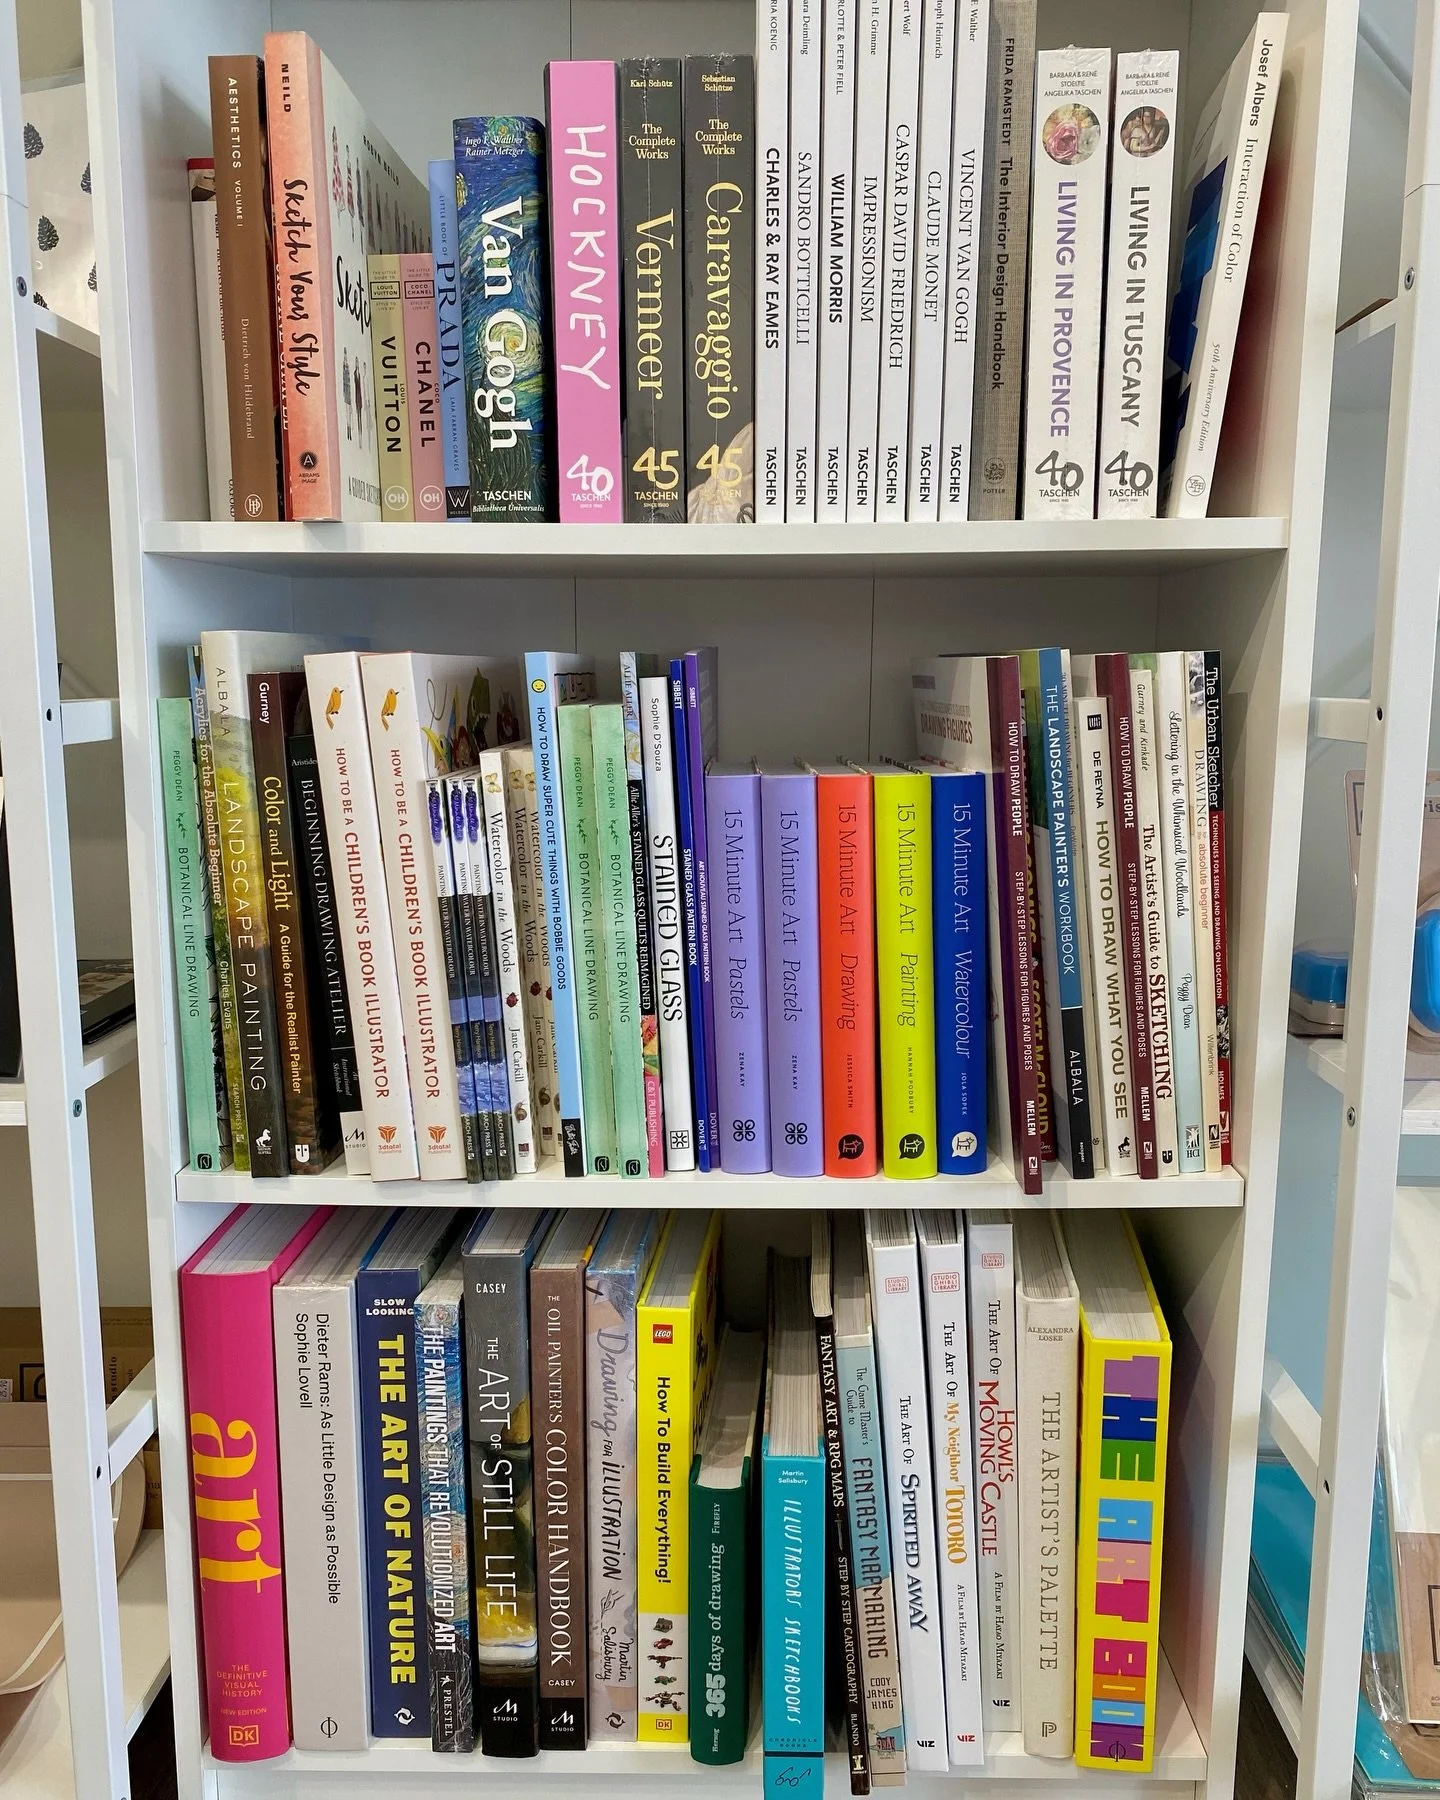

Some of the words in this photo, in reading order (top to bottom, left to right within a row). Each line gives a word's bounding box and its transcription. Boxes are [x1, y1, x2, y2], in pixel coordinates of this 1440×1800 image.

[701, 75, 736, 83] Sebastian
[836, 43, 844, 71] PETER
[1005, 38, 1015, 76] FRIDA
[1259, 39, 1273, 78] Josef
[281, 64, 291, 113] NEILD
[630, 79, 647, 88] Karl
[648, 79, 673, 88] Schütz
[836, 73, 844, 95] FIELL
[1075, 88, 1101, 96] TASCHEN
[1249, 81, 1269, 127] Albers
[642, 123, 662, 135] The
[1002, 79, 1014, 146] RAMSTEDT
[228, 77, 242, 169] AESTHETICS
[235, 180, 243, 220] VOLUME
[465, 147, 491, 156] Rainer
[493, 147, 525, 157] Metzger
[628, 136, 676, 147] Complete
[635, 149, 669, 160] Works
[894, 123, 910, 197] CASPAR
[766, 147, 780, 228] CHARLES
[797, 152, 812, 231] SANDRO
[959, 148, 975, 237] VINCENT
[1000, 157, 1013, 186] The
[1233, 138, 1258, 220] Interaction
[282, 178, 312, 263] Sketch
[830, 173, 845, 248] WILLIAM
[892, 202, 908, 263] DAVID
[926, 171, 942, 248] CLAUDE
[997, 188, 1011, 253] Interior
[1055, 181, 1078, 266] LIVING
[1127, 186, 1150, 271] LIVING
[1231, 222, 1243, 241] of
[481, 196, 524, 299] Van
[561, 124, 611, 390] HOCKNEY
[766, 232, 780, 247] &
[861, 176, 878, 323] IMPRESSIONISM
[957, 244, 972, 282] VAN
[1224, 243, 1242, 283] Color
[286, 271, 313, 319] Your
[766, 254, 779, 285] RAY
[796, 236, 811, 345] BOTTICELLI
[829, 255, 844, 324] MORRIS
[924, 254, 940, 322] MONET
[993, 254, 1009, 310] Design
[1054, 274, 1074, 299] IN
[1126, 278, 1146, 304] IN
[436, 262, 461, 391] PRADA
[635, 208, 675, 400] Vermeer
[695, 182, 744, 420] Caravaggio
[765, 291, 779, 349] EAMES
[889, 268, 907, 369] FRIEDRICH
[954, 287, 970, 344] GOGH
[241, 318, 251, 359] Dietrich
[287, 332, 320, 396] Style
[991, 311, 1007, 390] Handbook
[381, 335, 402, 453] VUITTON
[415, 341, 435, 448] CHANEL
[474, 308, 534, 452] Gogh
[1050, 307, 1074, 437] PROVENCE
[1120, 311, 1145, 428] TUSCANY
[244, 378, 255, 440] Hildebrand
[483, 490, 531, 500] TASCHEN
[766, 447, 776, 505] TASCHEN
[215, 667, 231, 736] ALBALA
[259, 682, 270, 725] Gurney
[1046, 685, 1058, 714] THE
[1206, 667, 1218, 695] The
[651, 697, 660, 731] Sophie
[1207, 700, 1219, 743] Urban
[653, 734, 662, 772] D'Souza
[1047, 716, 1064, 809] LANDSCAPE
[1092, 751, 1102, 768] DE
[1207, 747, 1219, 808] Sketcher
[263, 776, 282, 826] Color
[543, 785, 553, 818] SUPER
[838, 804, 857, 822] 15
[1093, 770, 1104, 809] REYNA
[269, 828, 283, 856] and
[490, 811, 507, 886] Watercolor
[546, 820, 556, 846] CUTE
[1053, 811, 1069, 888] PAINTER'S
[178, 847, 193, 920] BOTANICAL
[269, 860, 290, 911] Light
[548, 848, 558, 885] THINGS
[839, 829, 857, 898] Minute
[1144, 854, 1157, 908] Artist's
[183, 924, 195, 951] LINE
[224, 782, 254, 949] LANDSCAPE
[240, 963, 267, 1091] PAINTING
[840, 903, 858, 936] Art
[1059, 891, 1075, 975] WORKBOOK
[1147, 910, 1160, 953] Guide
[186, 956, 199, 1017] DRAWING
[410, 941, 428, 989] BOOK
[659, 949, 682, 1022] GLASS
[1150, 955, 1161, 970] to
[837, 953, 858, 1031] Drawing
[954, 950, 973, 1059] Watercolour
[1105, 973, 1123, 1029] WHAT
[416, 993, 440, 1099] ILLUSTRATOR
[1111, 1035, 1125, 1076] YOU
[1149, 973, 1173, 1100] SKETCHING
[1069, 1049, 1084, 1106] ALBALA
[1113, 1081, 1128, 1119] SEE
[1026, 1100, 1036, 1136] MELLEM
[476, 1283, 507, 1294] CASEY
[294, 1313, 310, 1363] Sophie
[316, 1313, 330, 1358] Dieter
[487, 1337, 498, 1360] THE
[547, 1308, 561, 1337] OIL
[654, 1330, 671, 1339] LEGO
[1027, 1326, 1074, 1334] ALEXANDRA
[298, 1367, 313, 1408] Lovell
[318, 1363, 332, 1408] Rams:
[378, 1334, 406, 1403] THE
[547, 1341, 563, 1423] PAINTER'S
[320, 1411, 333, 1428] As
[478, 1368, 510, 1430] ART
[657, 1377, 671, 1413] How
[1042, 1392, 1061, 1441] THE
[321, 1433, 334, 1469] Little
[381, 1413, 409, 1484] ART
[490, 1434, 501, 1450] OF
[657, 1418, 671, 1437] To
[978, 1380, 1000, 1474] MOVING
[997, 1410, 1015, 1483] HOWL'S
[545, 1430, 568, 1517] COLOR
[657, 1443, 671, 1485] Build
[190, 1412, 282, 1593] art
[321, 1473, 336, 1521] Design
[384, 1494, 411, 1538] OF
[481, 1459, 515, 1540] STILL
[900, 1472, 922, 1569] SPIRITED
[981, 1481, 1001, 1556] CASTLE
[1041, 1448, 1061, 1557] ARTIST'S
[326, 1524, 336, 1542] as
[654, 1489, 671, 1583] Everything!
[945, 1485, 968, 1565] TOTORO
[326, 1546, 341, 1604] Possible
[485, 1554, 517, 1617] LIFE
[548, 1523, 572, 1666] HANDBOOK
[708, 1543, 724, 1609] drawing
[386, 1550, 416, 1684] NATURE
[708, 1613, 721, 1631] of
[906, 1572, 929, 1634] AWAY
[1040, 1564, 1059, 1671] PALETTE
[708, 1635, 724, 1672] days
[548, 1679, 576, 1687] CASEY
[705, 1673, 726, 1718] 365
[866, 1688, 898, 1698] JAMES
[870, 1677, 891, 1687] CODY
[872, 1700, 894, 1709] KING
[233, 1730, 255, 1741] DK
[443, 1689, 454, 1737] PRESTEL
